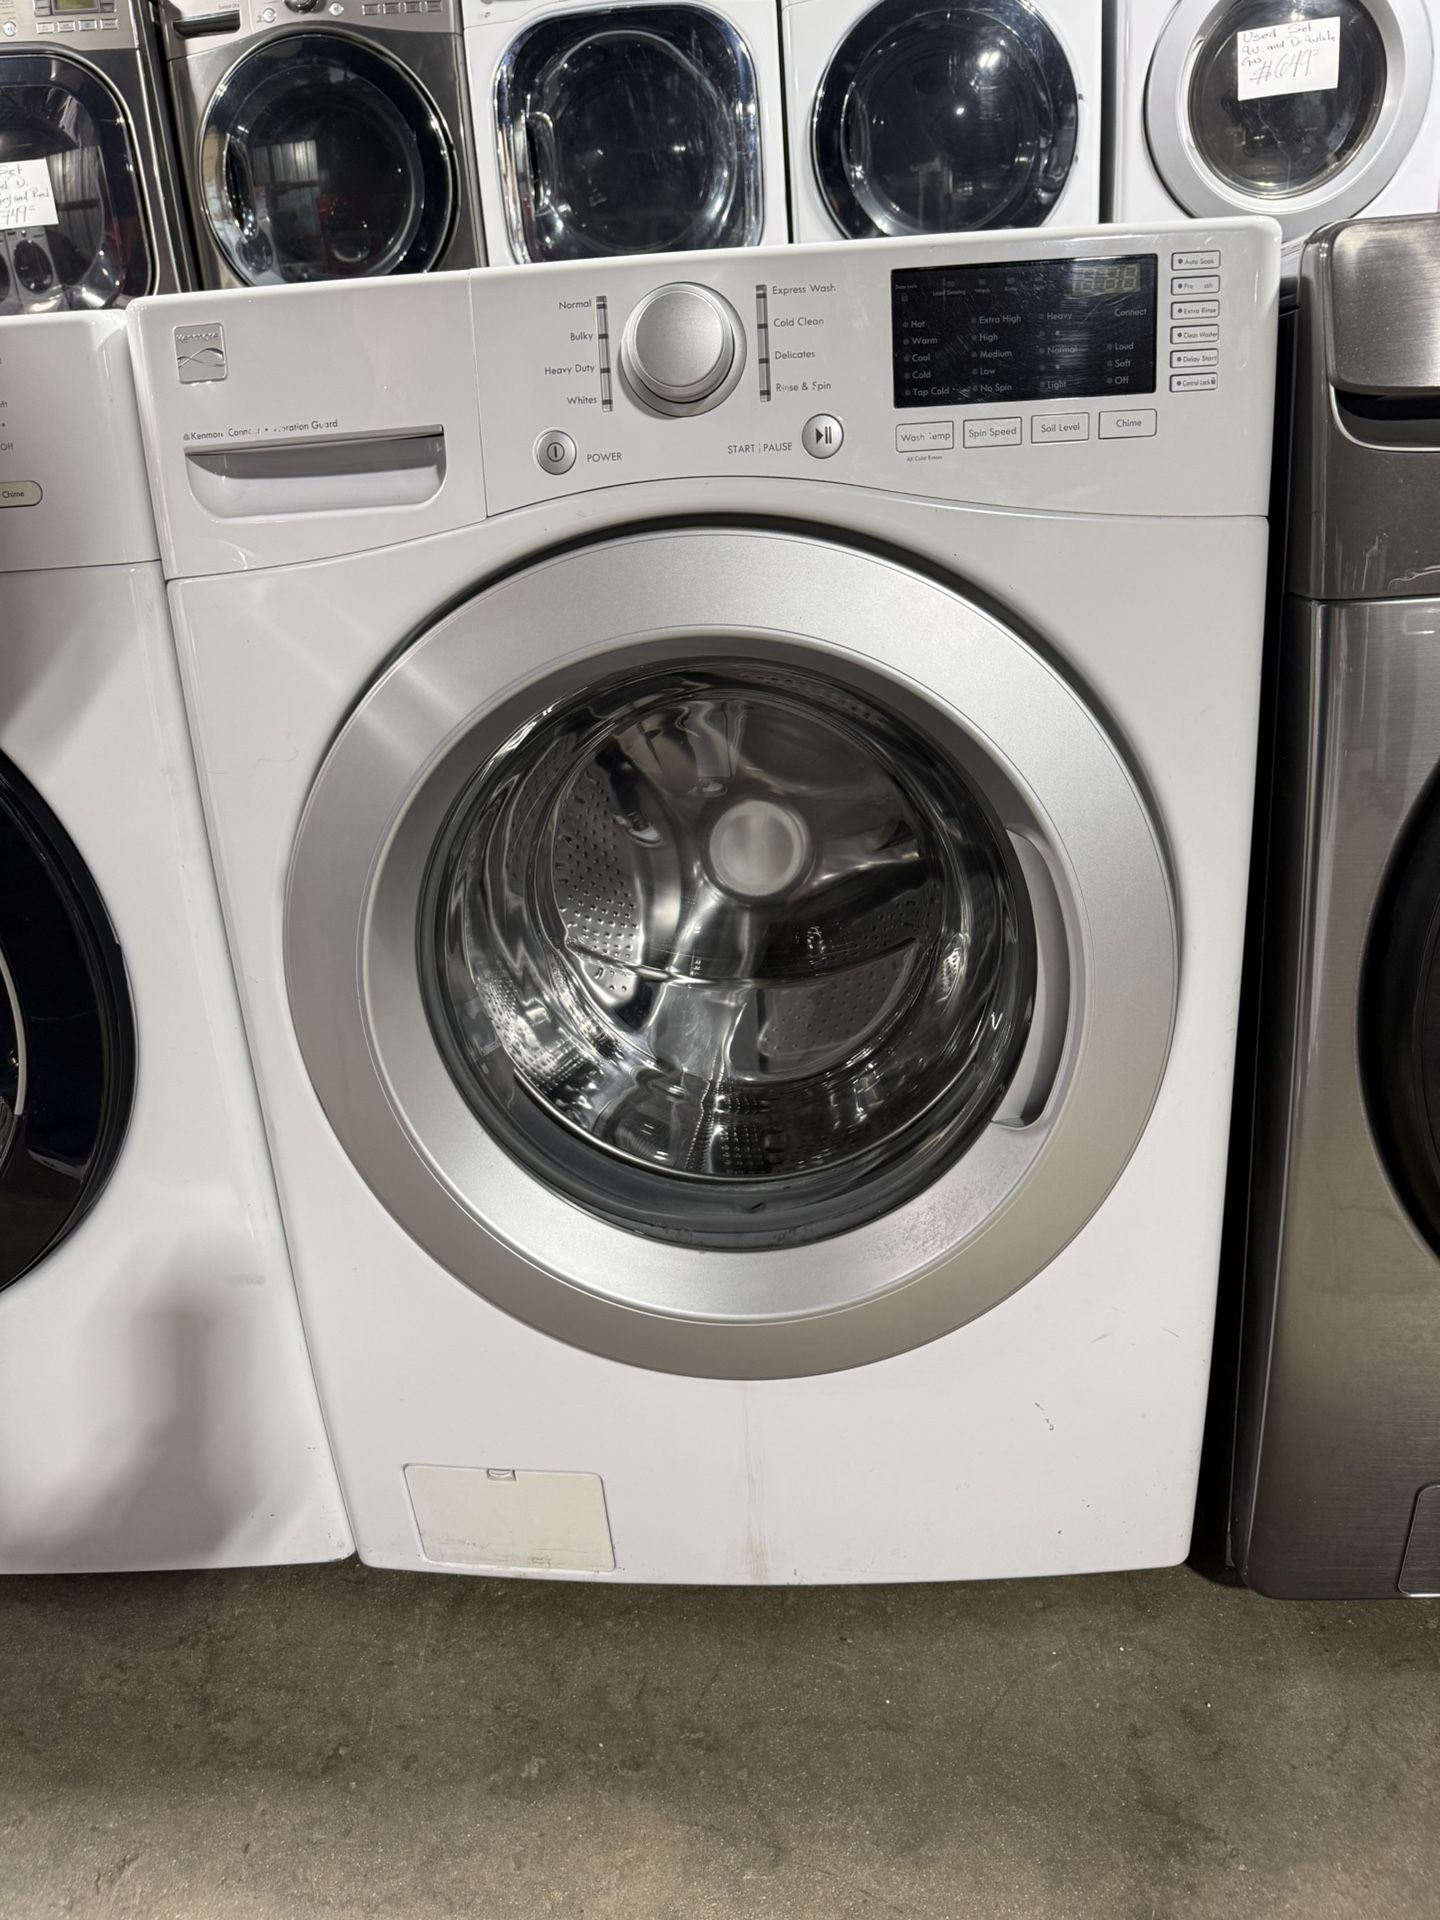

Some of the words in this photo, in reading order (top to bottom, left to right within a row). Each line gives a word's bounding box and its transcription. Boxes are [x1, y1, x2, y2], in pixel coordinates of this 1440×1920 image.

[1243, 28, 1276, 43] Used
[1288, 22, 1311, 34] Set
[772, 285, 807, 296] Express
[558, 299, 592, 310] Normal
[1046, 311, 1073, 321] Heavy
[1114, 307, 1147, 317] Connect
[773, 317, 795, 328] Cold
[797, 316, 825, 327] Clean
[911, 319, 926, 328] Hot
[979, 315, 1001, 325] Extra
[1002, 313, 1022, 324] High
[570, 332, 594, 342] Bulky
[912, 337, 938, 345] Warm
[979, 333, 999, 343] High
[1047, 344, 1079, 354] Normal
[1114, 341, 1135, 351] Loud
[774, 350, 816, 361] Delicates
[912, 353, 931, 362] Cool
[979, 349, 1013, 359] Medium
[1183, 355, 1200, 363] Delay
[1114, 358, 1132, 368] Soft
[544, 366, 573, 376] Heavy
[575, 364, 595, 374] Duty
[912, 370, 931, 379] Cold
[980, 367, 996, 376] Low
[1047, 379, 1067, 390] Light
[1114, 375, 1130, 385] Off
[775, 381, 799, 392] Rinse
[801, 381, 809, 391] &
[912, 387, 929, 397] Tap
[931, 386, 950, 395] Cold
[980, 383, 994, 393] No
[994, 382, 1013, 393] Spin
[566, 396, 598, 405] Whites
[1041, 424, 1057, 433] Soil
[1059, 422, 1080, 432] Level
[1115, 418, 1142, 428] Chime
[900, 432, 926, 442] Wash
[968, 428, 987, 439] Spin
[989, 426, 1017, 437] Speed
[0, 442, 14, 451] Off
[727, 444, 755, 455] START
[763, 442, 793, 453] PAUSE
[586, 451, 623, 463] POWER
[2, 490, 25, 499] Chime
